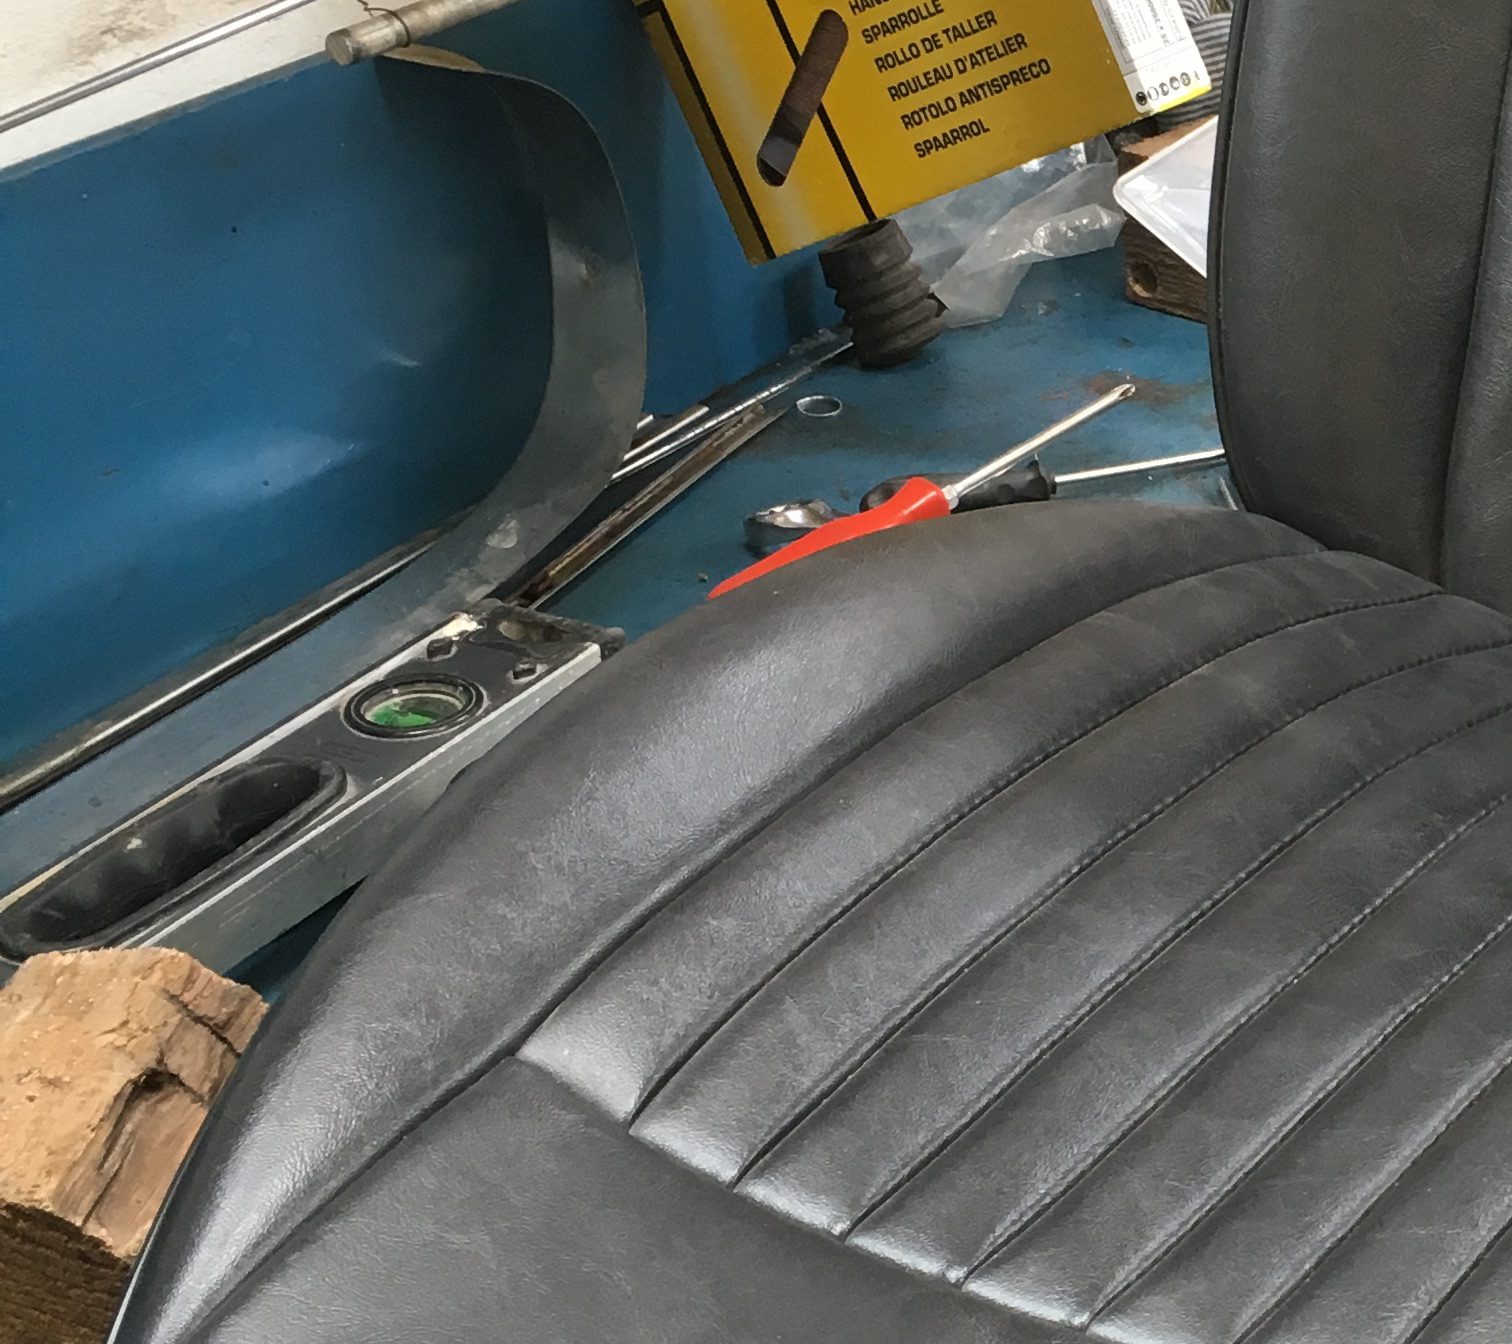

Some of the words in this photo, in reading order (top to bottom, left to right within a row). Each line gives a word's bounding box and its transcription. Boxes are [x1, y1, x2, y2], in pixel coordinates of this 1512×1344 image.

[874, 42, 921, 73] ROLLO
[920, 33, 943, 54] DE
[943, 10, 998, 44] TALLER
[887, 63, 954, 102] ROULEAU
[954, 33, 1027, 75] D'ATELIER
[901, 96, 956, 130] ROTOLO
[959, 58, 1051, 108] ANTISPRECO
[914, 119, 991, 158] SPAARROL
